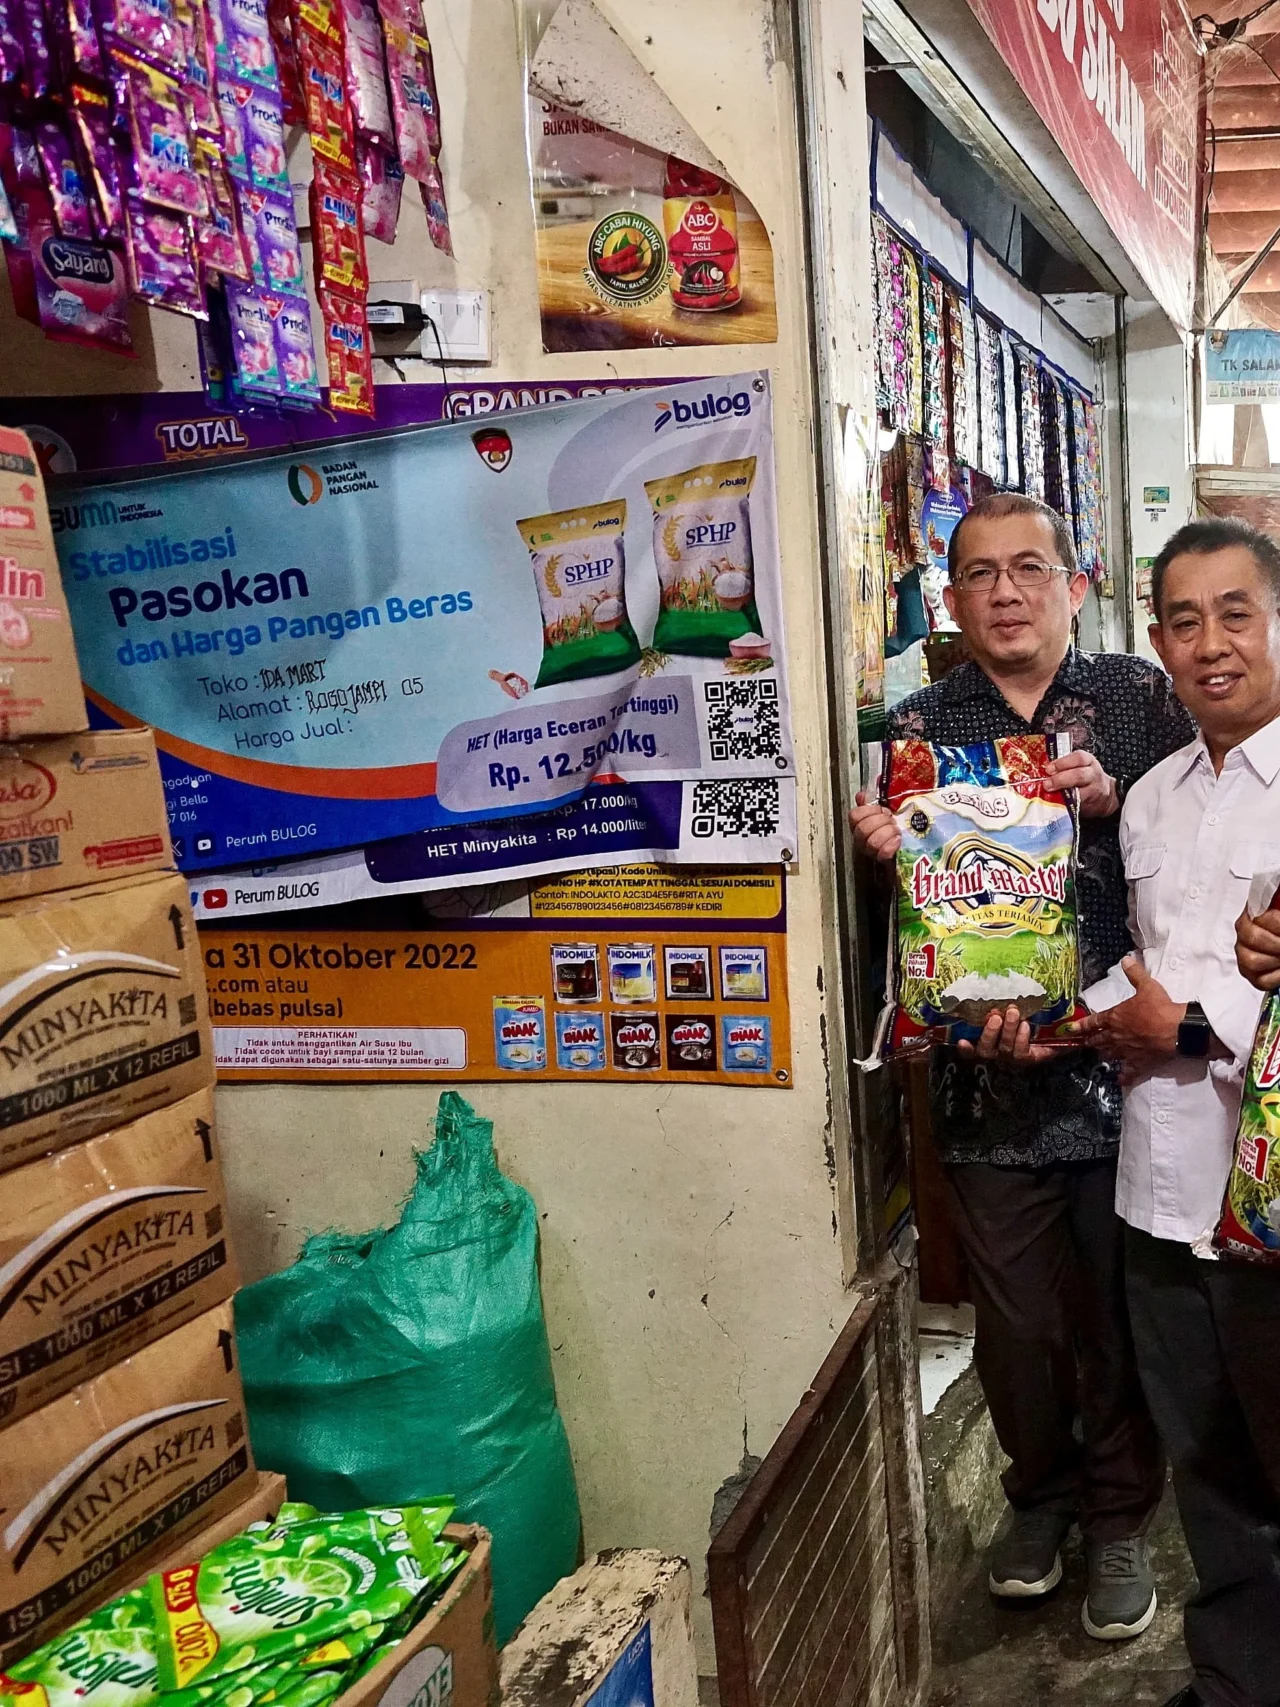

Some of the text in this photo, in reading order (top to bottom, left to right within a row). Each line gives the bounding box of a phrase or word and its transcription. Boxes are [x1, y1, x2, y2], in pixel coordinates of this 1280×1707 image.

[543, 119, 579, 136] BUKAN
[324, 194, 357, 226] Klin
[687, 213, 714, 227] ABC
[594, 216, 661, 254] ABC CABAI HIYUNG
[692, 242, 711, 251] ASLI
[50, 244, 110, 278] Sayang
[644, 280, 670, 305] SAMBAL
[331, 323, 363, 350] Klin
[1221, 360, 1237, 371] TK
[671, 391, 752, 425] bulog
[163, 419, 246, 450] TOTAL
[323, 461, 357, 475] BADAN
[327, 470, 367, 486] PANGAN
[329, 480, 379, 496] NASIONAL
[685, 521, 736, 546] SPHP
[69, 527, 237, 583] Stabilisasi
[564, 556, 614, 584] SPHP
[109, 566, 310, 628] Pasokan
[117, 588, 473, 667] dan Harga Pangan Beras
[198, 675, 248, 697] Toko
[286, 658, 327, 689] MART
[218, 695, 292, 723] Alamat
[235, 717, 343, 750] Harga Jual
[467, 732, 491, 753] HET
[492, 727, 543, 751] (Harga
[547, 714, 606, 739] Eceran
[488, 761, 530, 791] Rp.
[180, 811, 198, 822] 016
[226, 822, 318, 849] Perum BULOG
[427, 818, 647, 858] HET Minyakita Rp 14.000/liter
[621, 867, 645, 876] Kode
[912, 855, 1068, 907] Grand Master
[234, 881, 320, 906] Perum BULOG
[534, 890, 723, 899] Contoh: INDOLAKTO AYU
[696, 902, 722, 911] KEDIRI
[998, 909, 1045, 932] TERJAMIN
[234, 942, 261, 969] 31
[269, 942, 397, 970] Oktober
[404, 942, 479, 970] 2022
[555, 949, 595, 959] INDOMILK
[611, 949, 652, 959] INDOMILK
[668, 952, 704, 961] INDOMILK
[724, 953, 760, 961] INDOMILK
[908, 943, 936, 979] No: 1
[266, 977, 309, 994] atau
[279, 997, 345, 1021] pulsa)
[1, 985, 168, 1072] MINYAKITA
[297, 1030, 358, 1040] PERHATIKAN!
[234, 1047, 424, 1057] Tidak cocok untuk bayi sampai usia 12 bulan
[246, 1038, 269, 1048] Tidak
[271, 1039, 296, 1048] untuk
[359, 1038, 372, 1048] Air
[374, 1039, 396, 1048] Susu
[398, 1038, 412, 1048] Ibu
[214, 1055, 234, 1065] idak
[235, 1055, 259, 1066] dapat
[261, 1055, 305, 1066] digunakan
[306, 1055, 341, 1066] sebagai
[399, 1056, 432, 1066] sumber
[20, 1084, 68, 1117] 1000
[72, 1076, 102, 1098] ML
[125, 1057, 145, 1079] 12
[149, 1040, 195, 1071] REFIL
[1238, 1136, 1270, 1183] No: 1
[22, 1209, 196, 1317] MINYAKITA
[150, 1279, 171, 1302] 12
[175, 1253, 221, 1288] REFIL
[42, 1424, 215, 1557] MINYAKITA
[8, 1598, 44, 1633] ISI
[196, 1457, 242, 1504] REFIL
[222, 1557, 344, 1630] Sunlight
